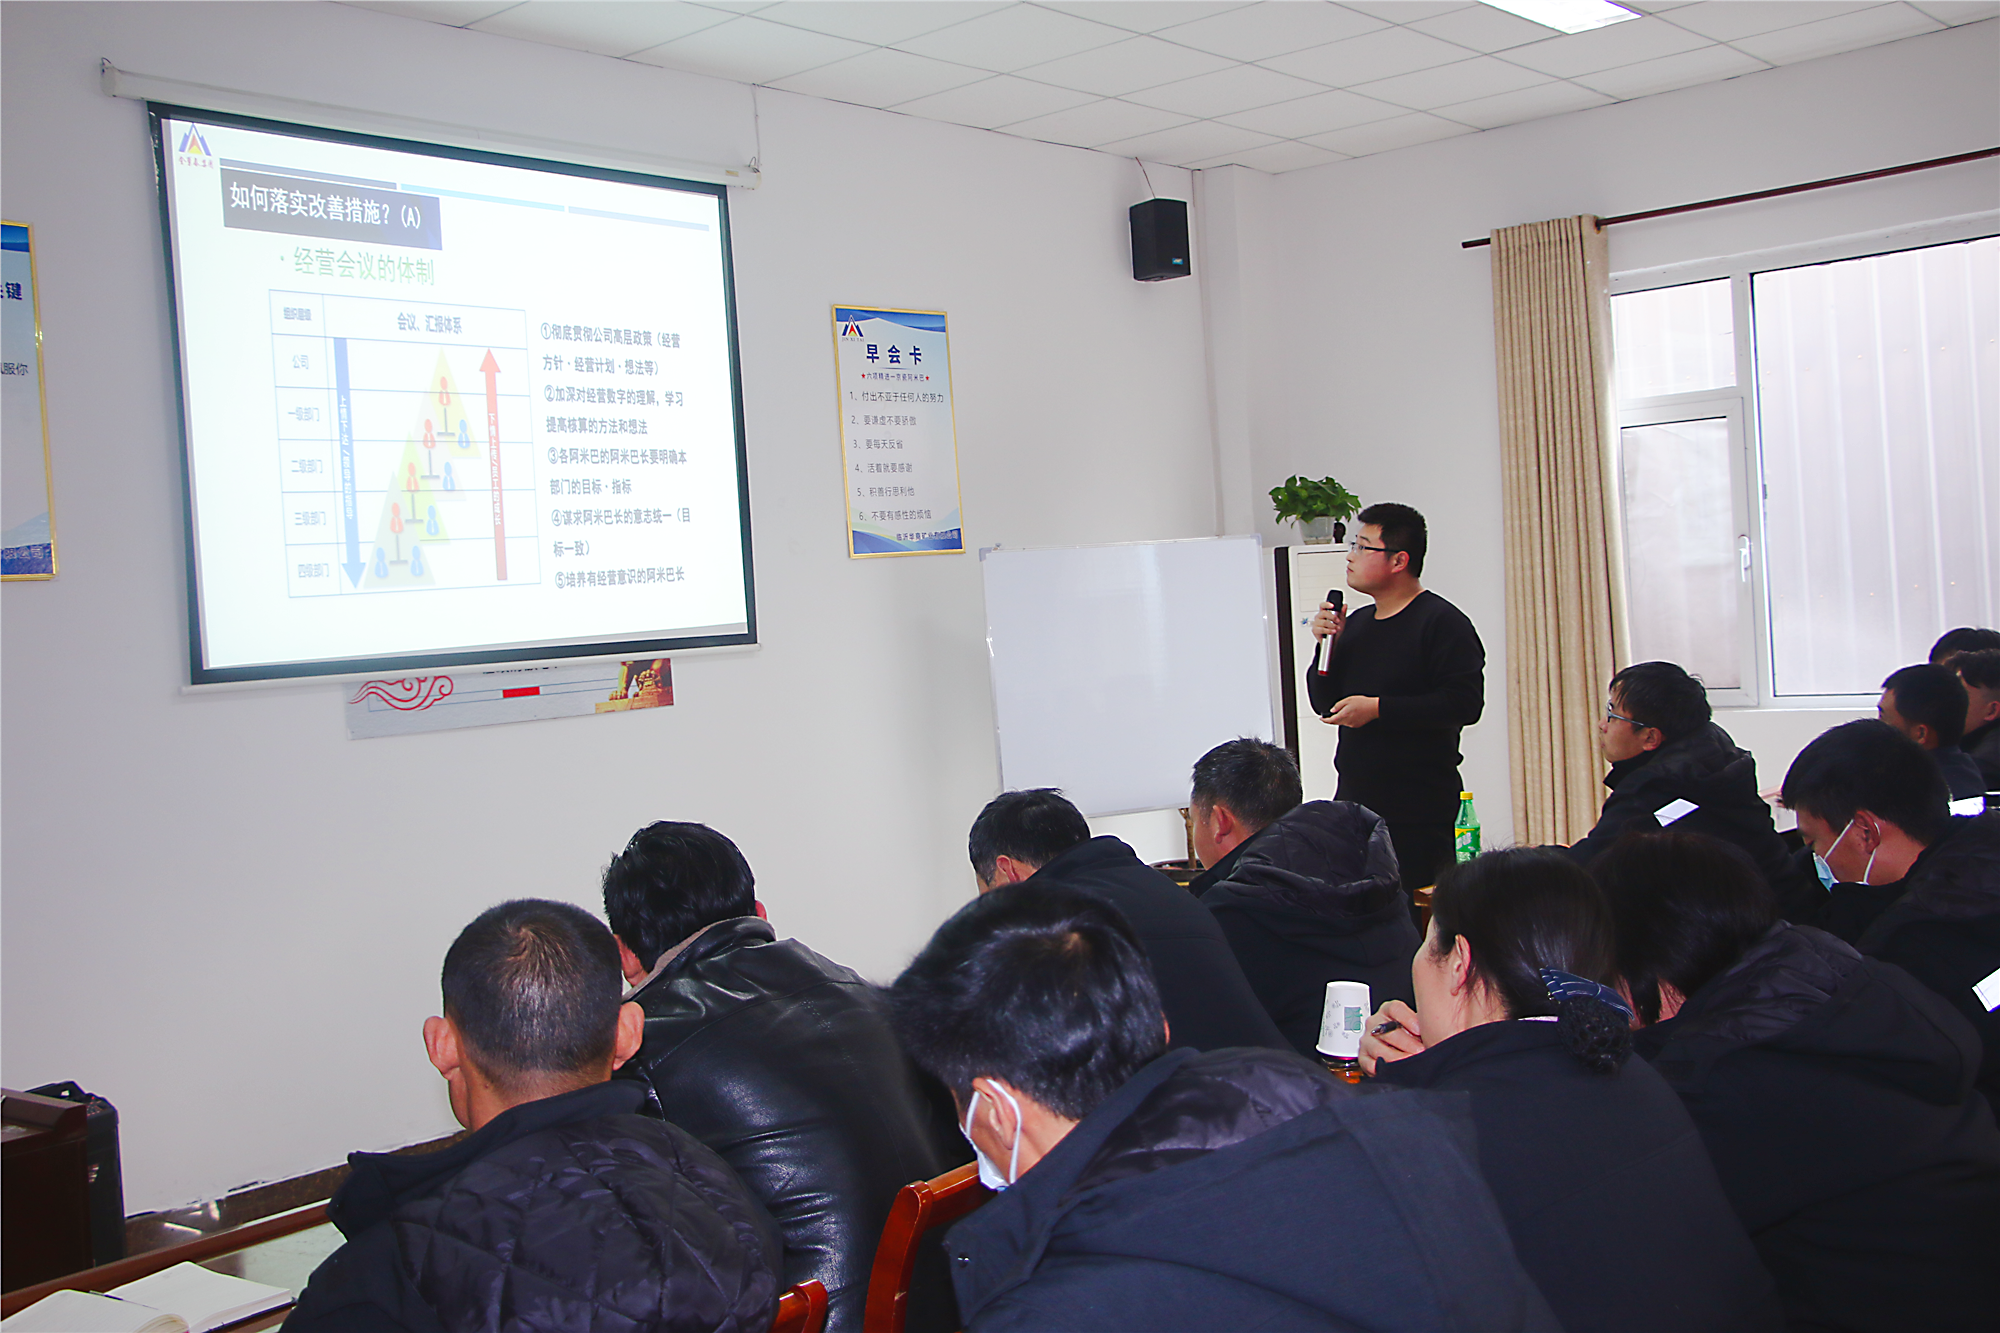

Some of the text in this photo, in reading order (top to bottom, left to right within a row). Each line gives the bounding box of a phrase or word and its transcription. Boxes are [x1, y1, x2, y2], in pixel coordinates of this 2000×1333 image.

[293, 247, 435, 286] 经营会议的体制
[0, 281, 23, 300] 键
[397, 312, 463, 335] 会议、汇报体系
[292, 355, 310, 370] 公司
[866, 344, 922, 366] 早会卡
[0, 362, 29, 376] 服你
[287, 406, 320, 422] 一级部门
[545, 416, 648, 435] 提高核算的方法和想法
[291, 459, 323, 474] 二级部门
[294, 511, 326, 526] 三级部门
